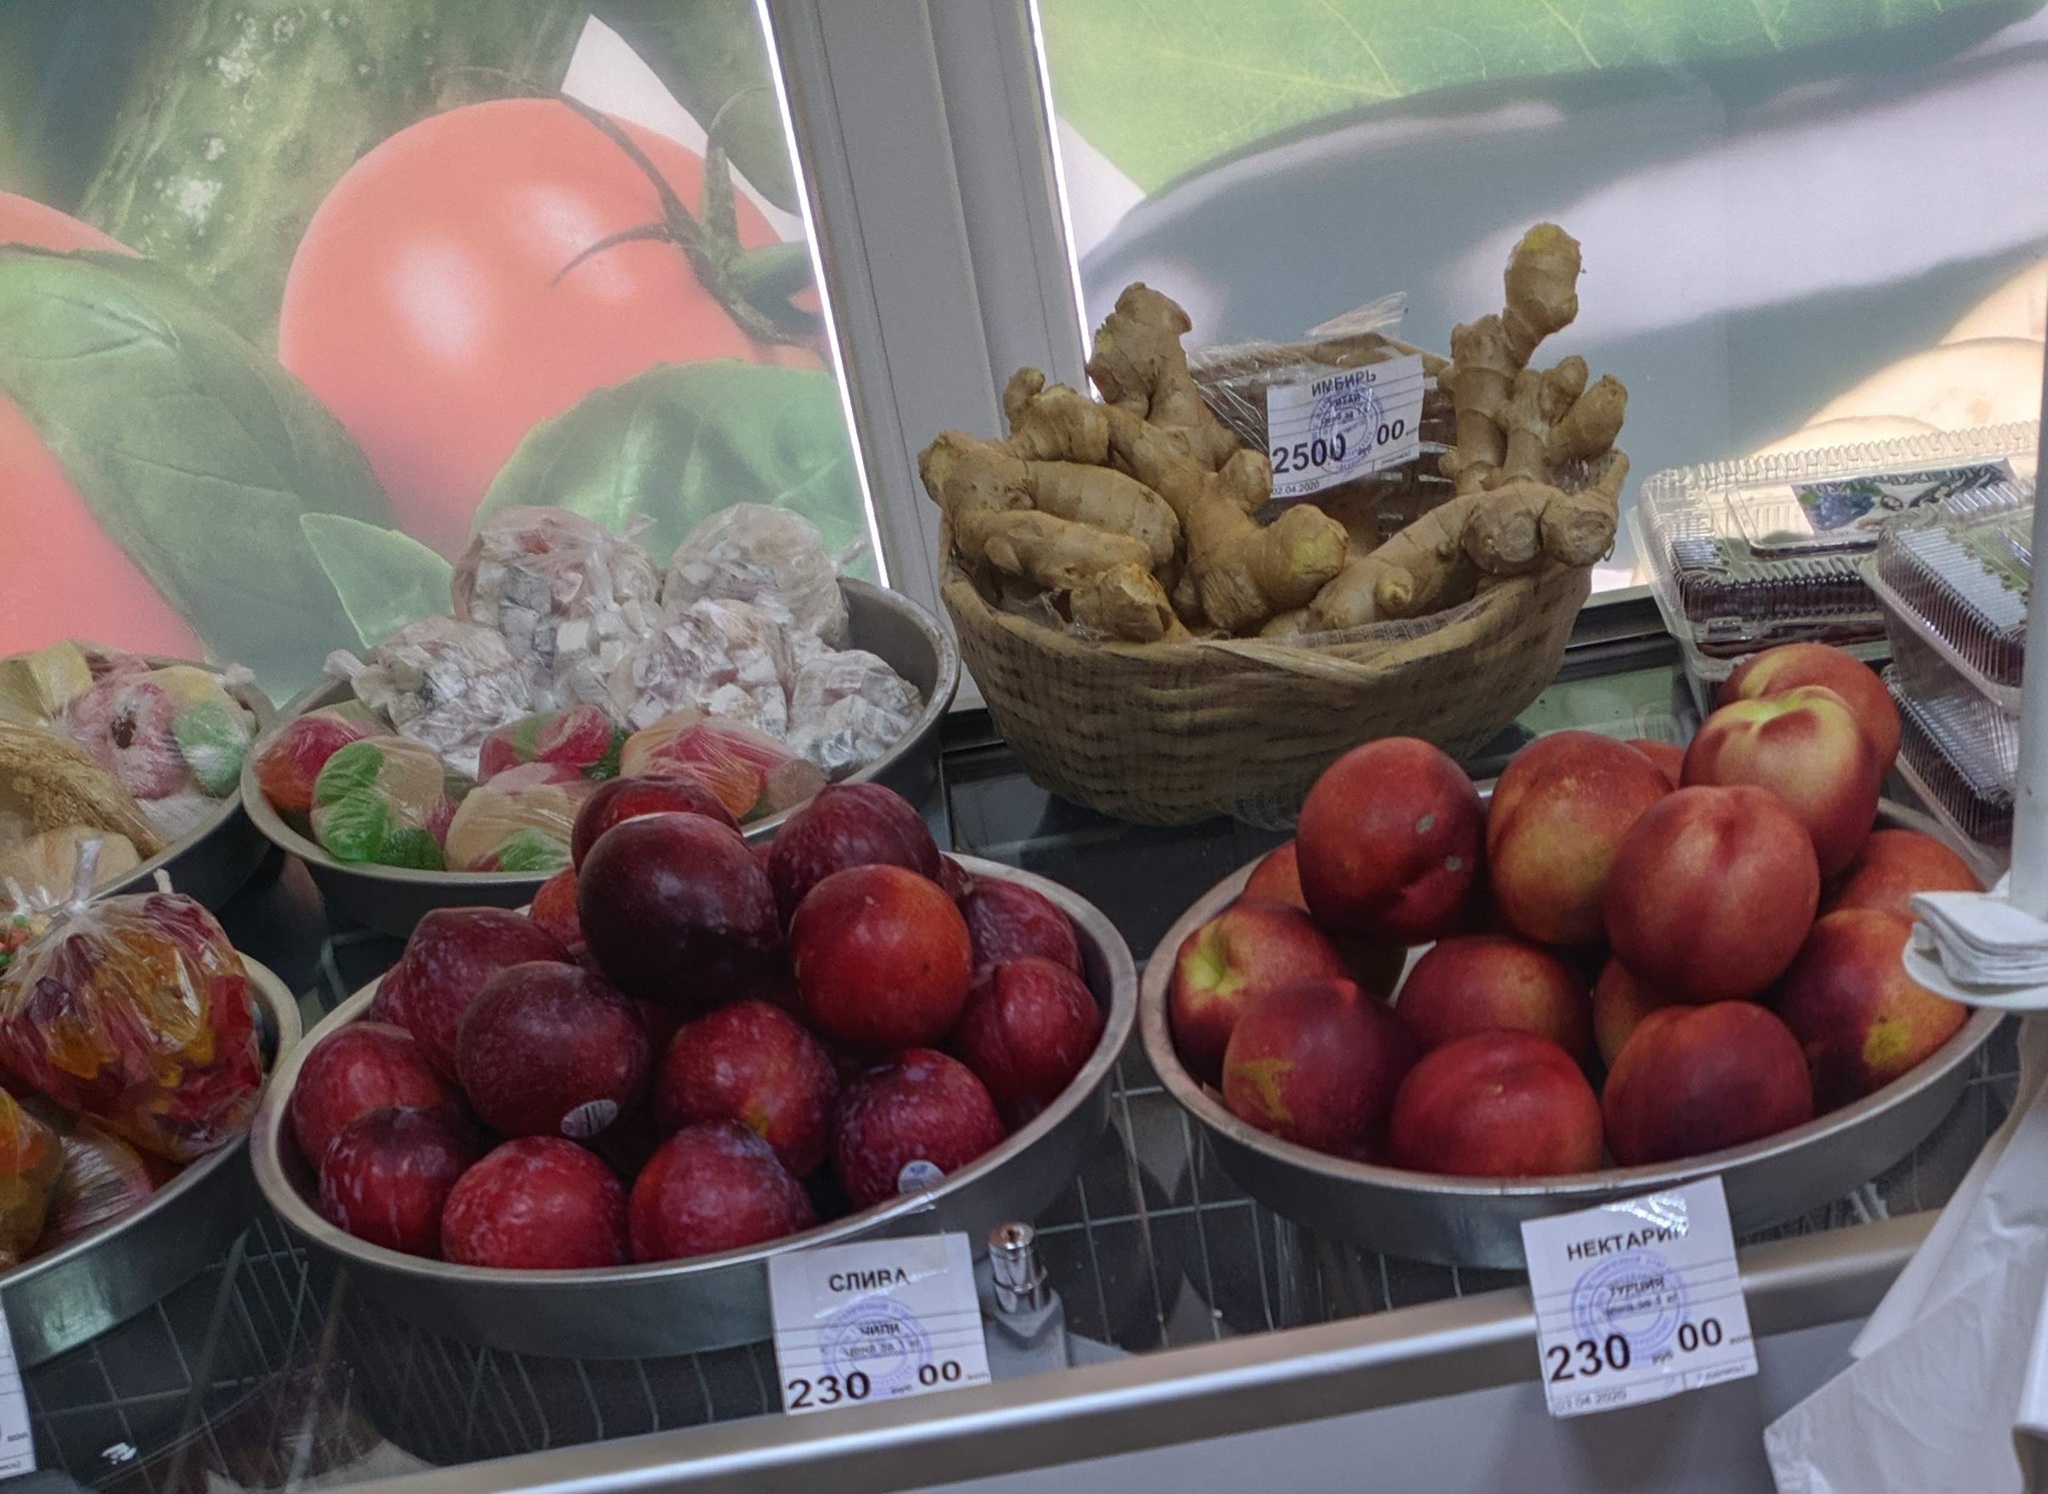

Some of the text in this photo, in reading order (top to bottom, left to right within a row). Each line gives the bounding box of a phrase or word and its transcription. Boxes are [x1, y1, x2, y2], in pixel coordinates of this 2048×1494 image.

[1311, 369, 1377, 397] ИМБИРЬ
[1272, 433, 1347, 475] 2500
[1376, 418, 1405, 446] 00
[829, 1267, 911, 1293] СЛИВА
[1546, 1332, 1631, 1384] 230
[1677, 1317, 1722, 1353] 00
[787, 1360, 962, 1410] 230 00
